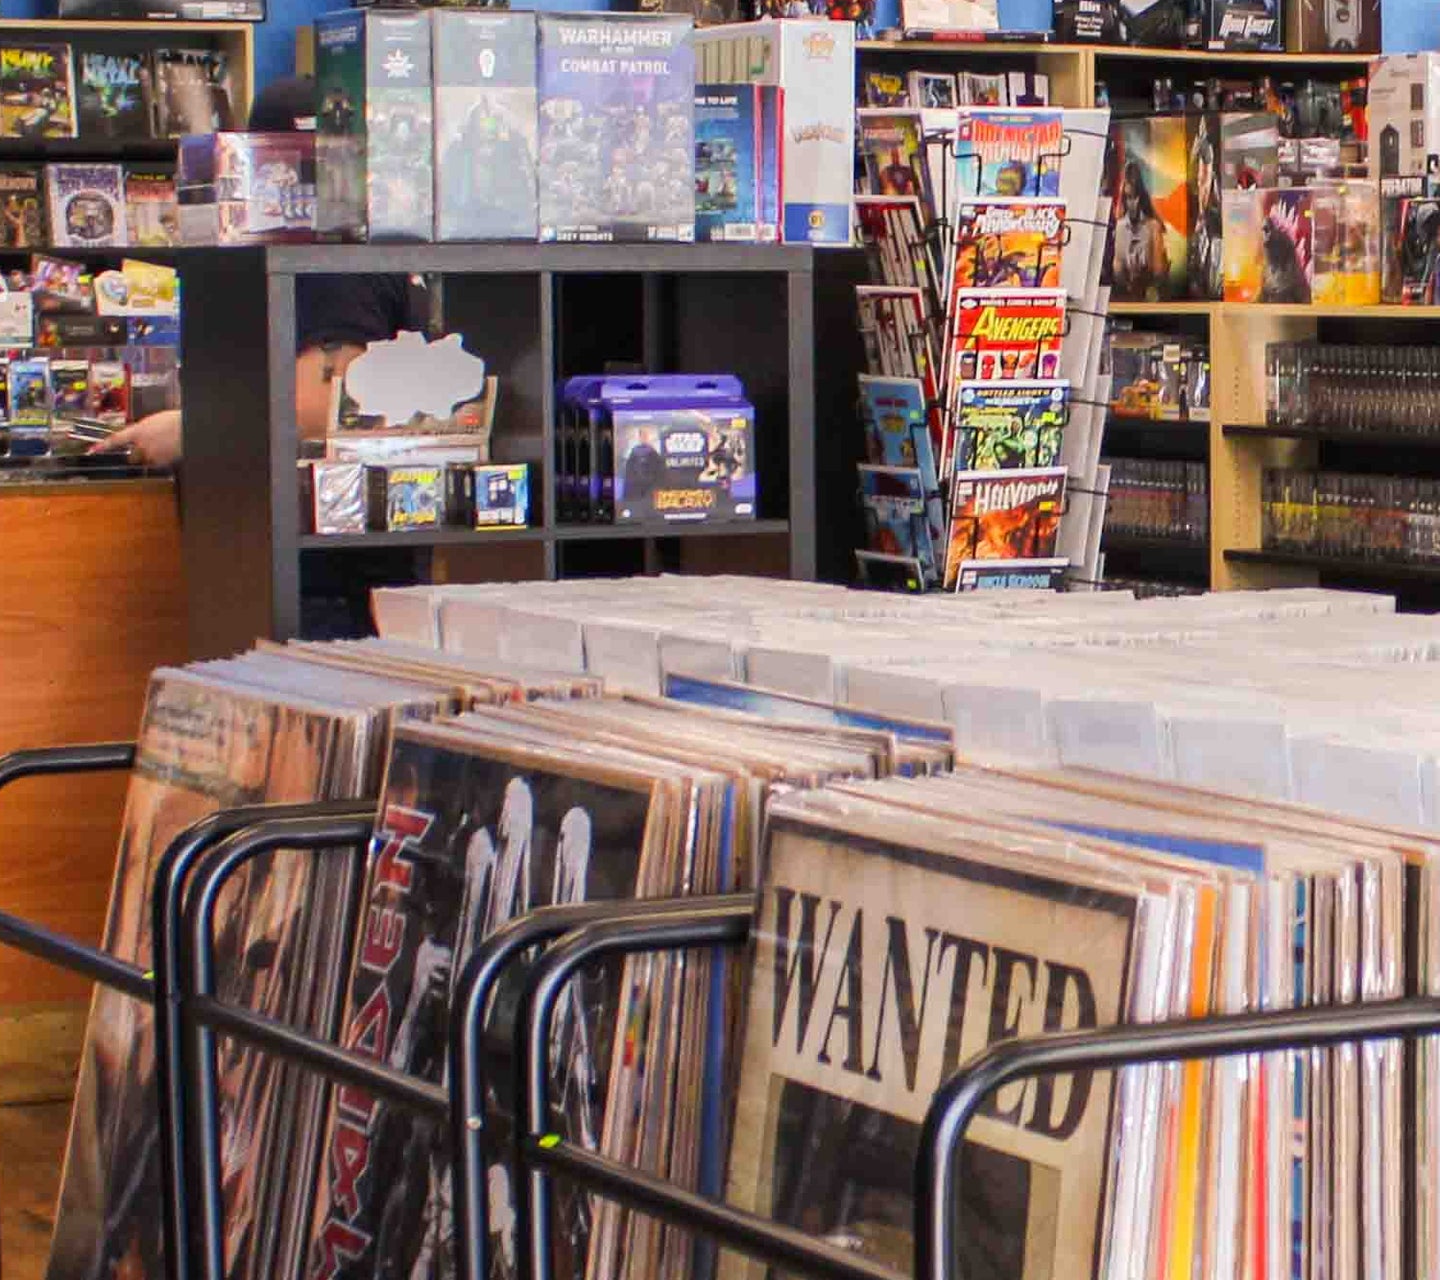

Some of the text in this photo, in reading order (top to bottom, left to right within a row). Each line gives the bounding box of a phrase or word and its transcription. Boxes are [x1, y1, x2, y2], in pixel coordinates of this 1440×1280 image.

[1078, 0, 1101, 13] Bin
[559, 27, 672, 47] WARHAMMER
[561, 59, 671, 75] COMBAT PATROL
[964, 307, 1059, 349] AVENGERS
[765, 887, 1101, 1146] WANTED
